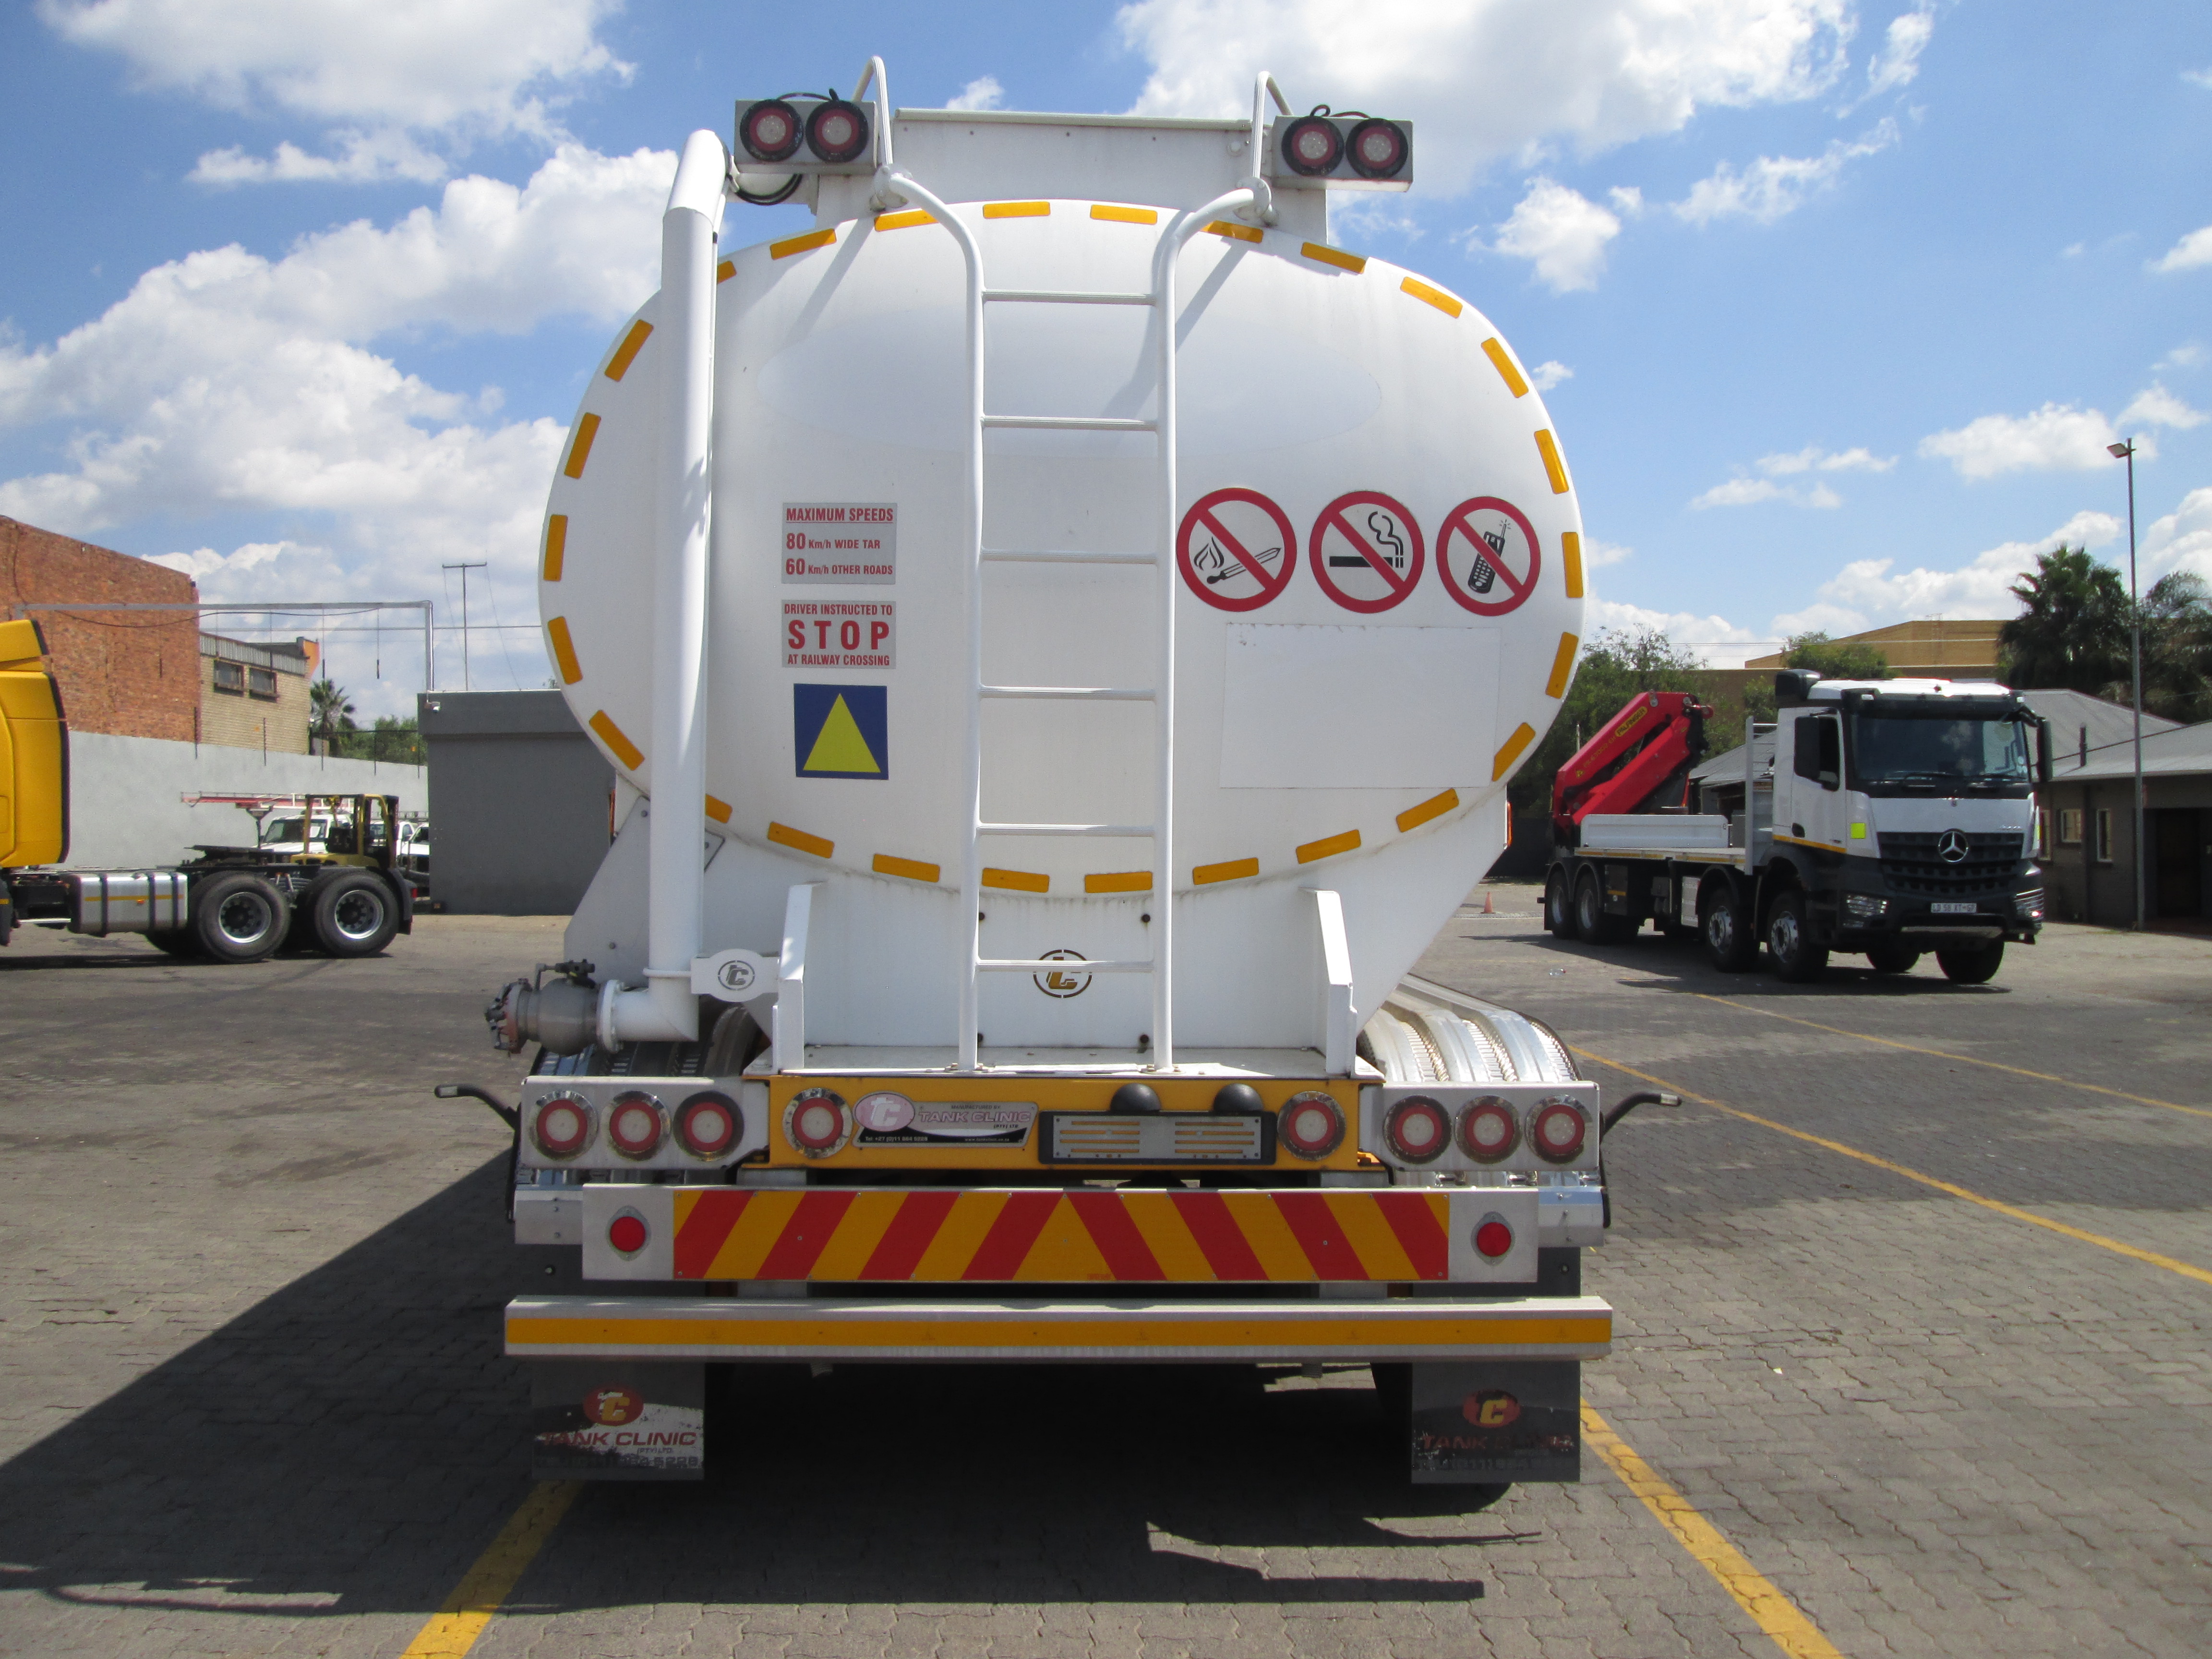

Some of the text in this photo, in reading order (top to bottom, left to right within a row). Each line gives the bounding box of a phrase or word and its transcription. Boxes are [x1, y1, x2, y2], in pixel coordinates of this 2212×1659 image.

[786, 507, 893, 522] MAXIMUM SPEEDS
[786, 532, 880, 550] 80 Km/h WIDE TAR
[785, 558, 893, 575] 60 Km/h OTHER ROADS
[784, 603, 893, 616] DRIVER INSTRUCTED TO
[788, 619, 890, 650] STOP
[787, 654, 890, 666] AT RAILWAY CROSSING
[1617, 708, 1646, 735] PALFINGER
[919, 1111, 1031, 1123] TANK CLINIC
[540, 1431, 697, 1446] TANK CLINIC
[1421, 1435, 1488, 1449] TANK
